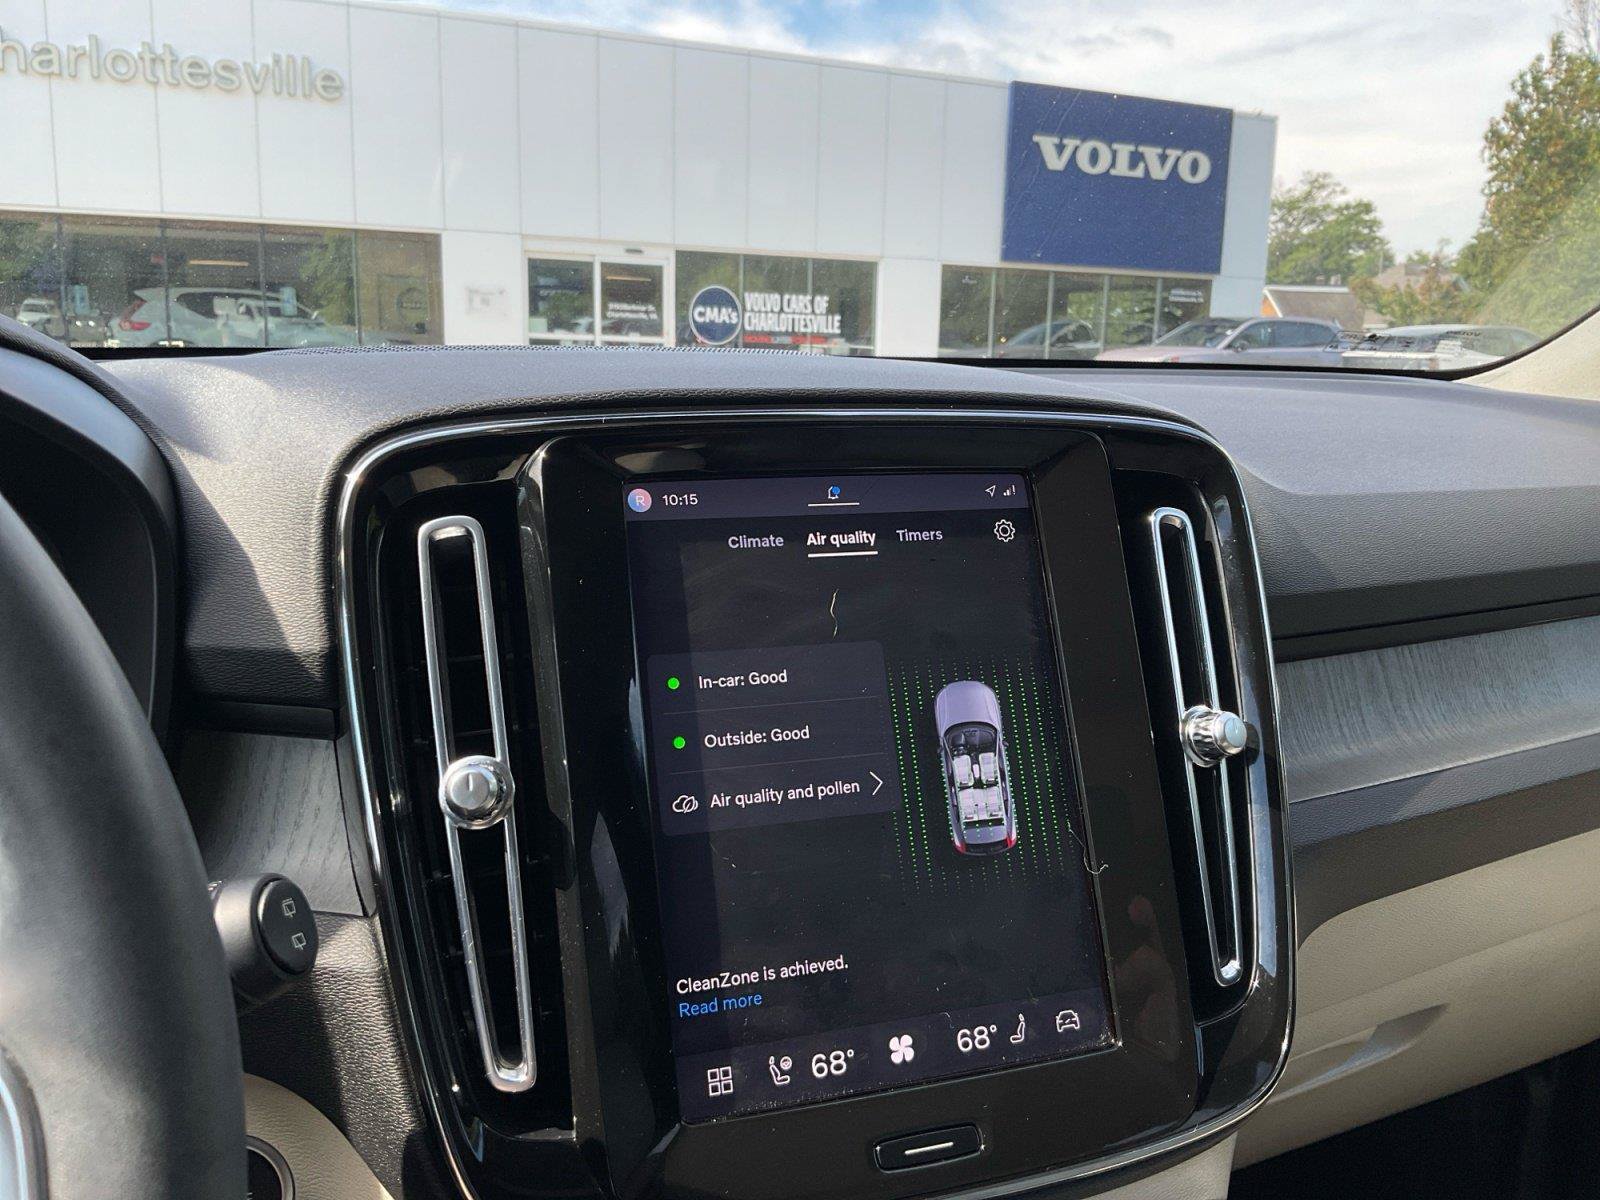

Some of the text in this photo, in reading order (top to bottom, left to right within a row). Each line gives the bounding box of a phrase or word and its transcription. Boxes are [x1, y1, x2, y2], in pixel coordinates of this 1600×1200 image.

[0, 25, 344, 101] harlottesville
[1033, 134, 1212, 184] VOLVO
[693, 305, 738, 325] CMA's
[744, 292, 830, 315] VOLVO CARS OF
[743, 311, 842, 333] CHARLOTTESVILLE
[634, 493, 699, 507] R 10:15
[727, 533, 785, 549] Climate
[806, 530, 876, 548] Air quality
[896, 527, 943, 543] Timers
[698, 669, 788, 690] In-car: Good
[704, 726, 810, 749] Outside: Good
[710, 778, 860, 809] Air quality and pollen
[676, 955, 849, 995] CleanZone is achieved.
[679, 995, 763, 1018] Read more
[957, 1025, 998, 1053] 68°
[811, 1049, 855, 1079] 68°
